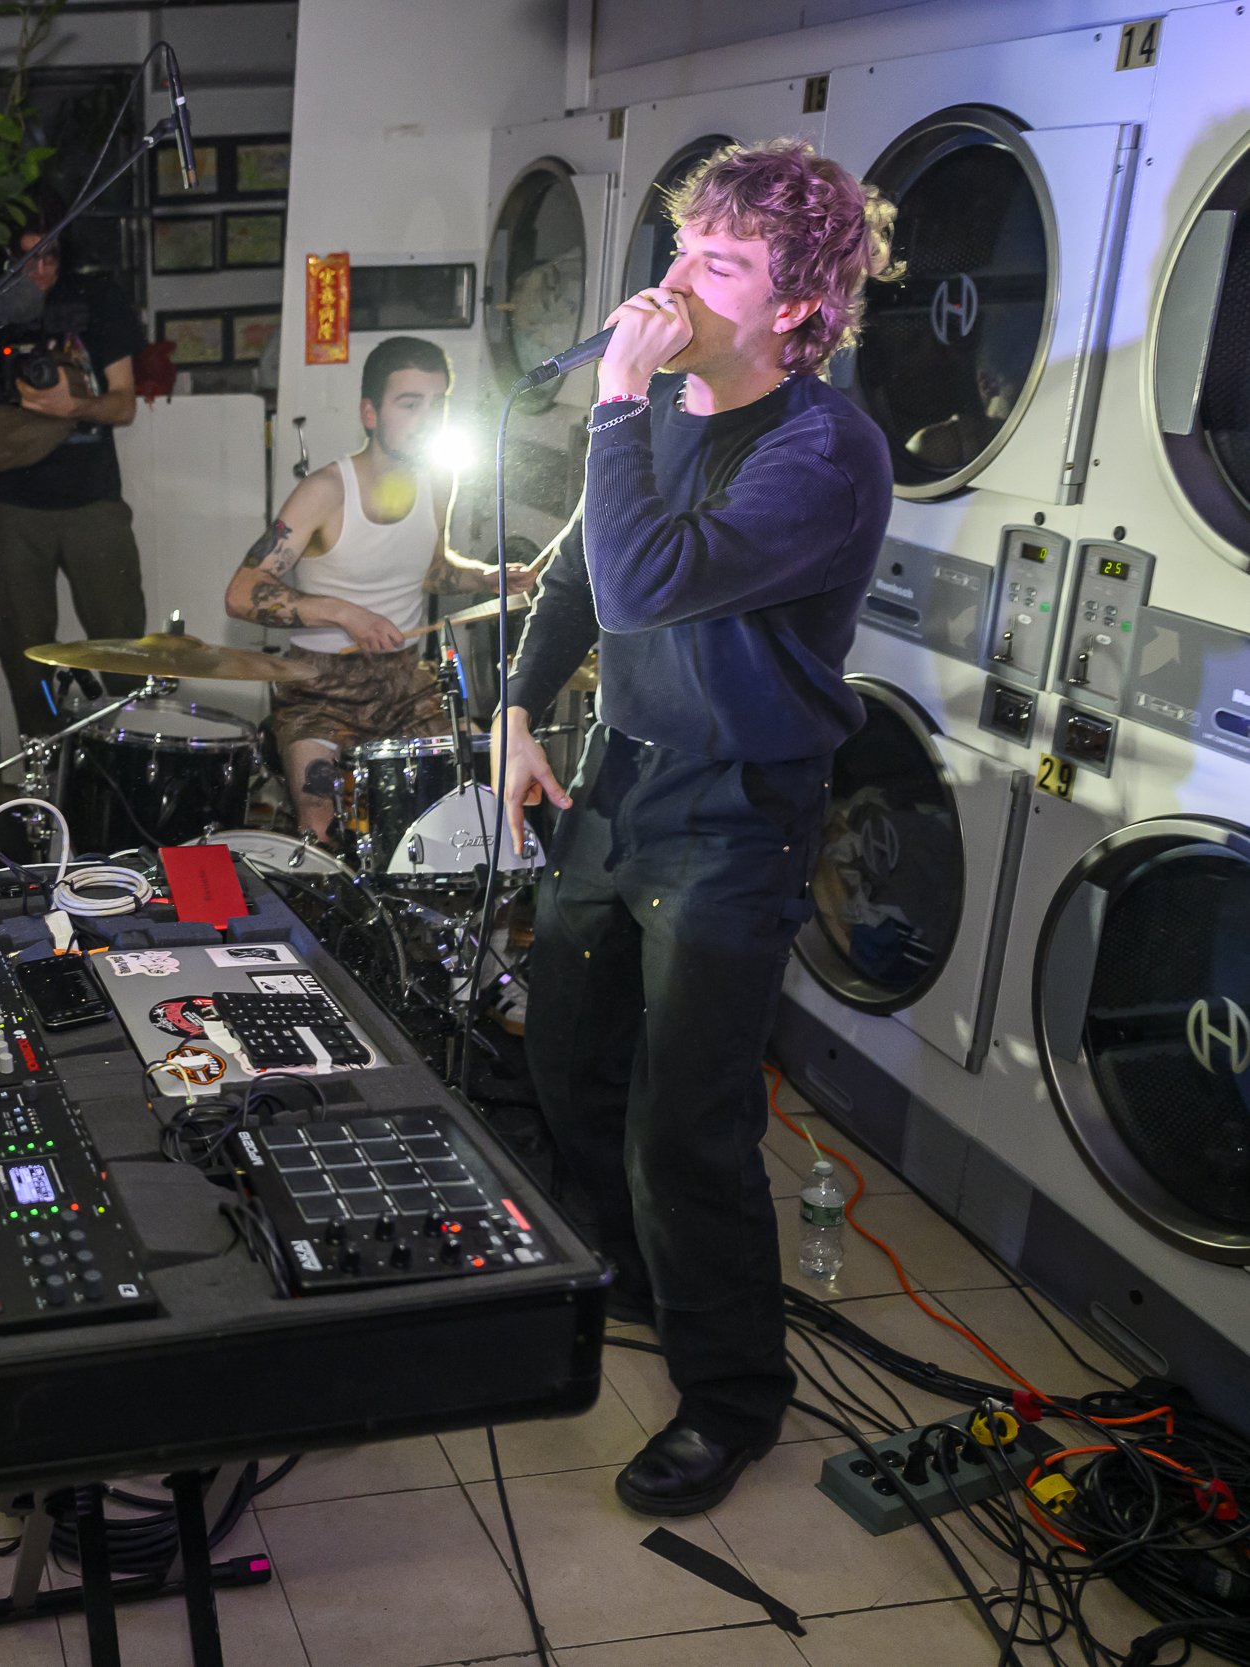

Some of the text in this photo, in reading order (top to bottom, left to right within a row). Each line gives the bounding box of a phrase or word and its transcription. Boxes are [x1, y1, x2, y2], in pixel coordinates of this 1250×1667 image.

[1123, 22, 1156, 67] 14
[1040, 548, 1047, 559] 0
[1104, 562, 1121, 575] 25
[1039, 757, 1073, 797] 29
[238, 1131, 264, 1166] MPD218
[291, 1240, 323, 1271] AKAI
